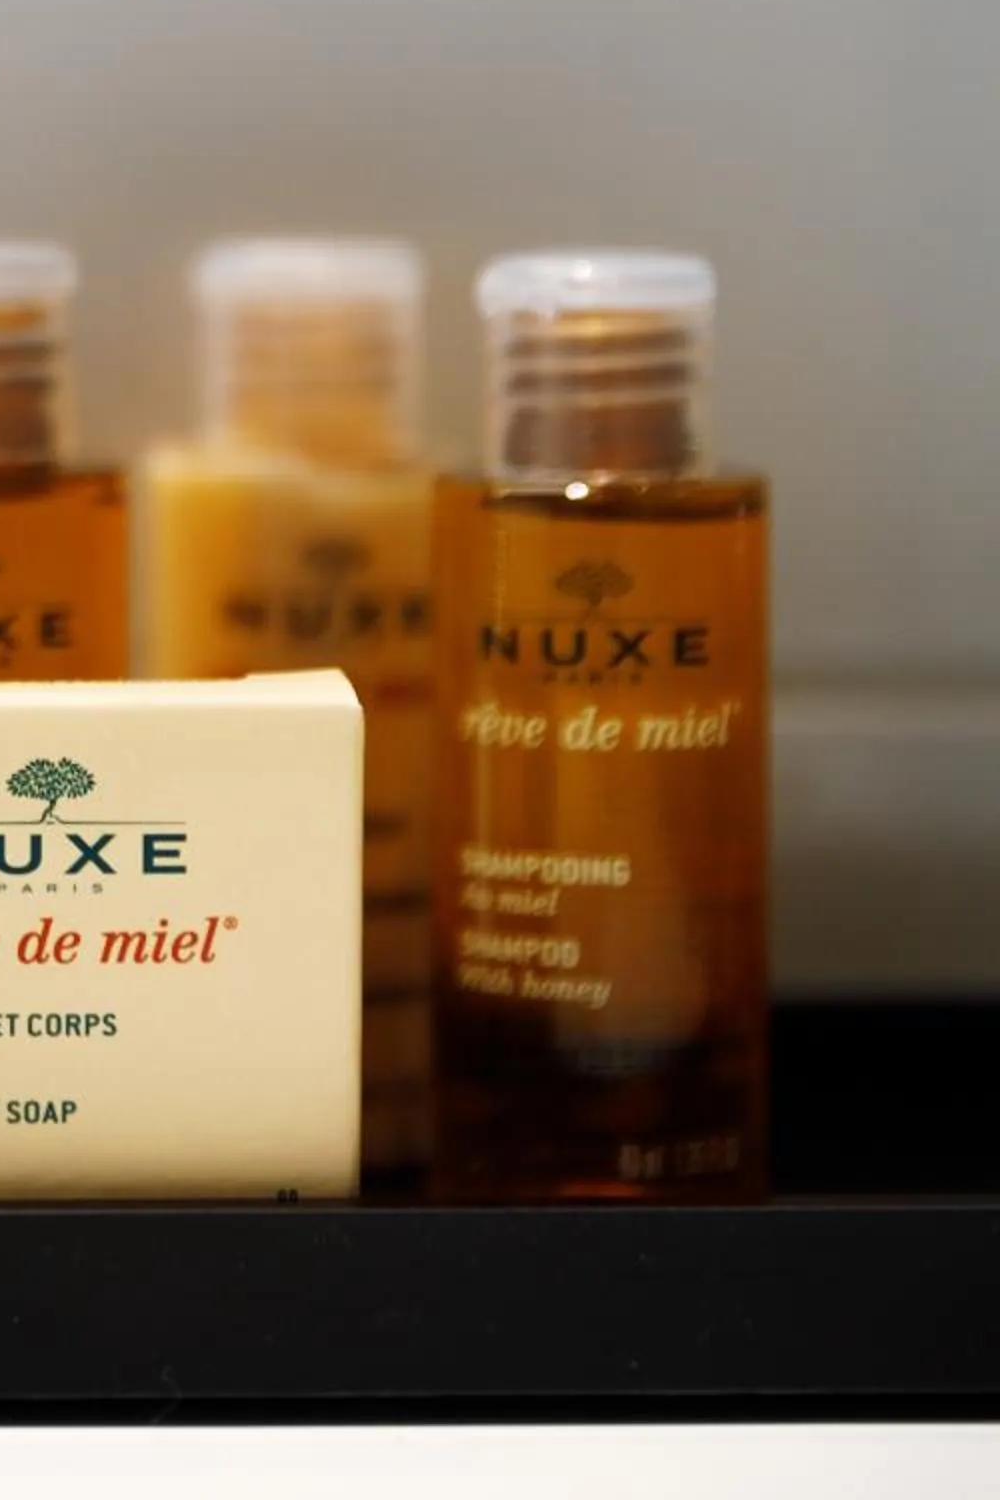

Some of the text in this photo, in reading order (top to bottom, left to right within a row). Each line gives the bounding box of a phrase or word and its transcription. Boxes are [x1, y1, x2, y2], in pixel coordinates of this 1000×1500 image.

[480, 625, 711, 667] NUXE
[560, 706, 622, 750] de
[17, 917, 81, 964] de
[522, 971, 611, 1009] honey
[27, 1013, 117, 1037] CORPS
[6, 1101, 77, 1124] SOAP
